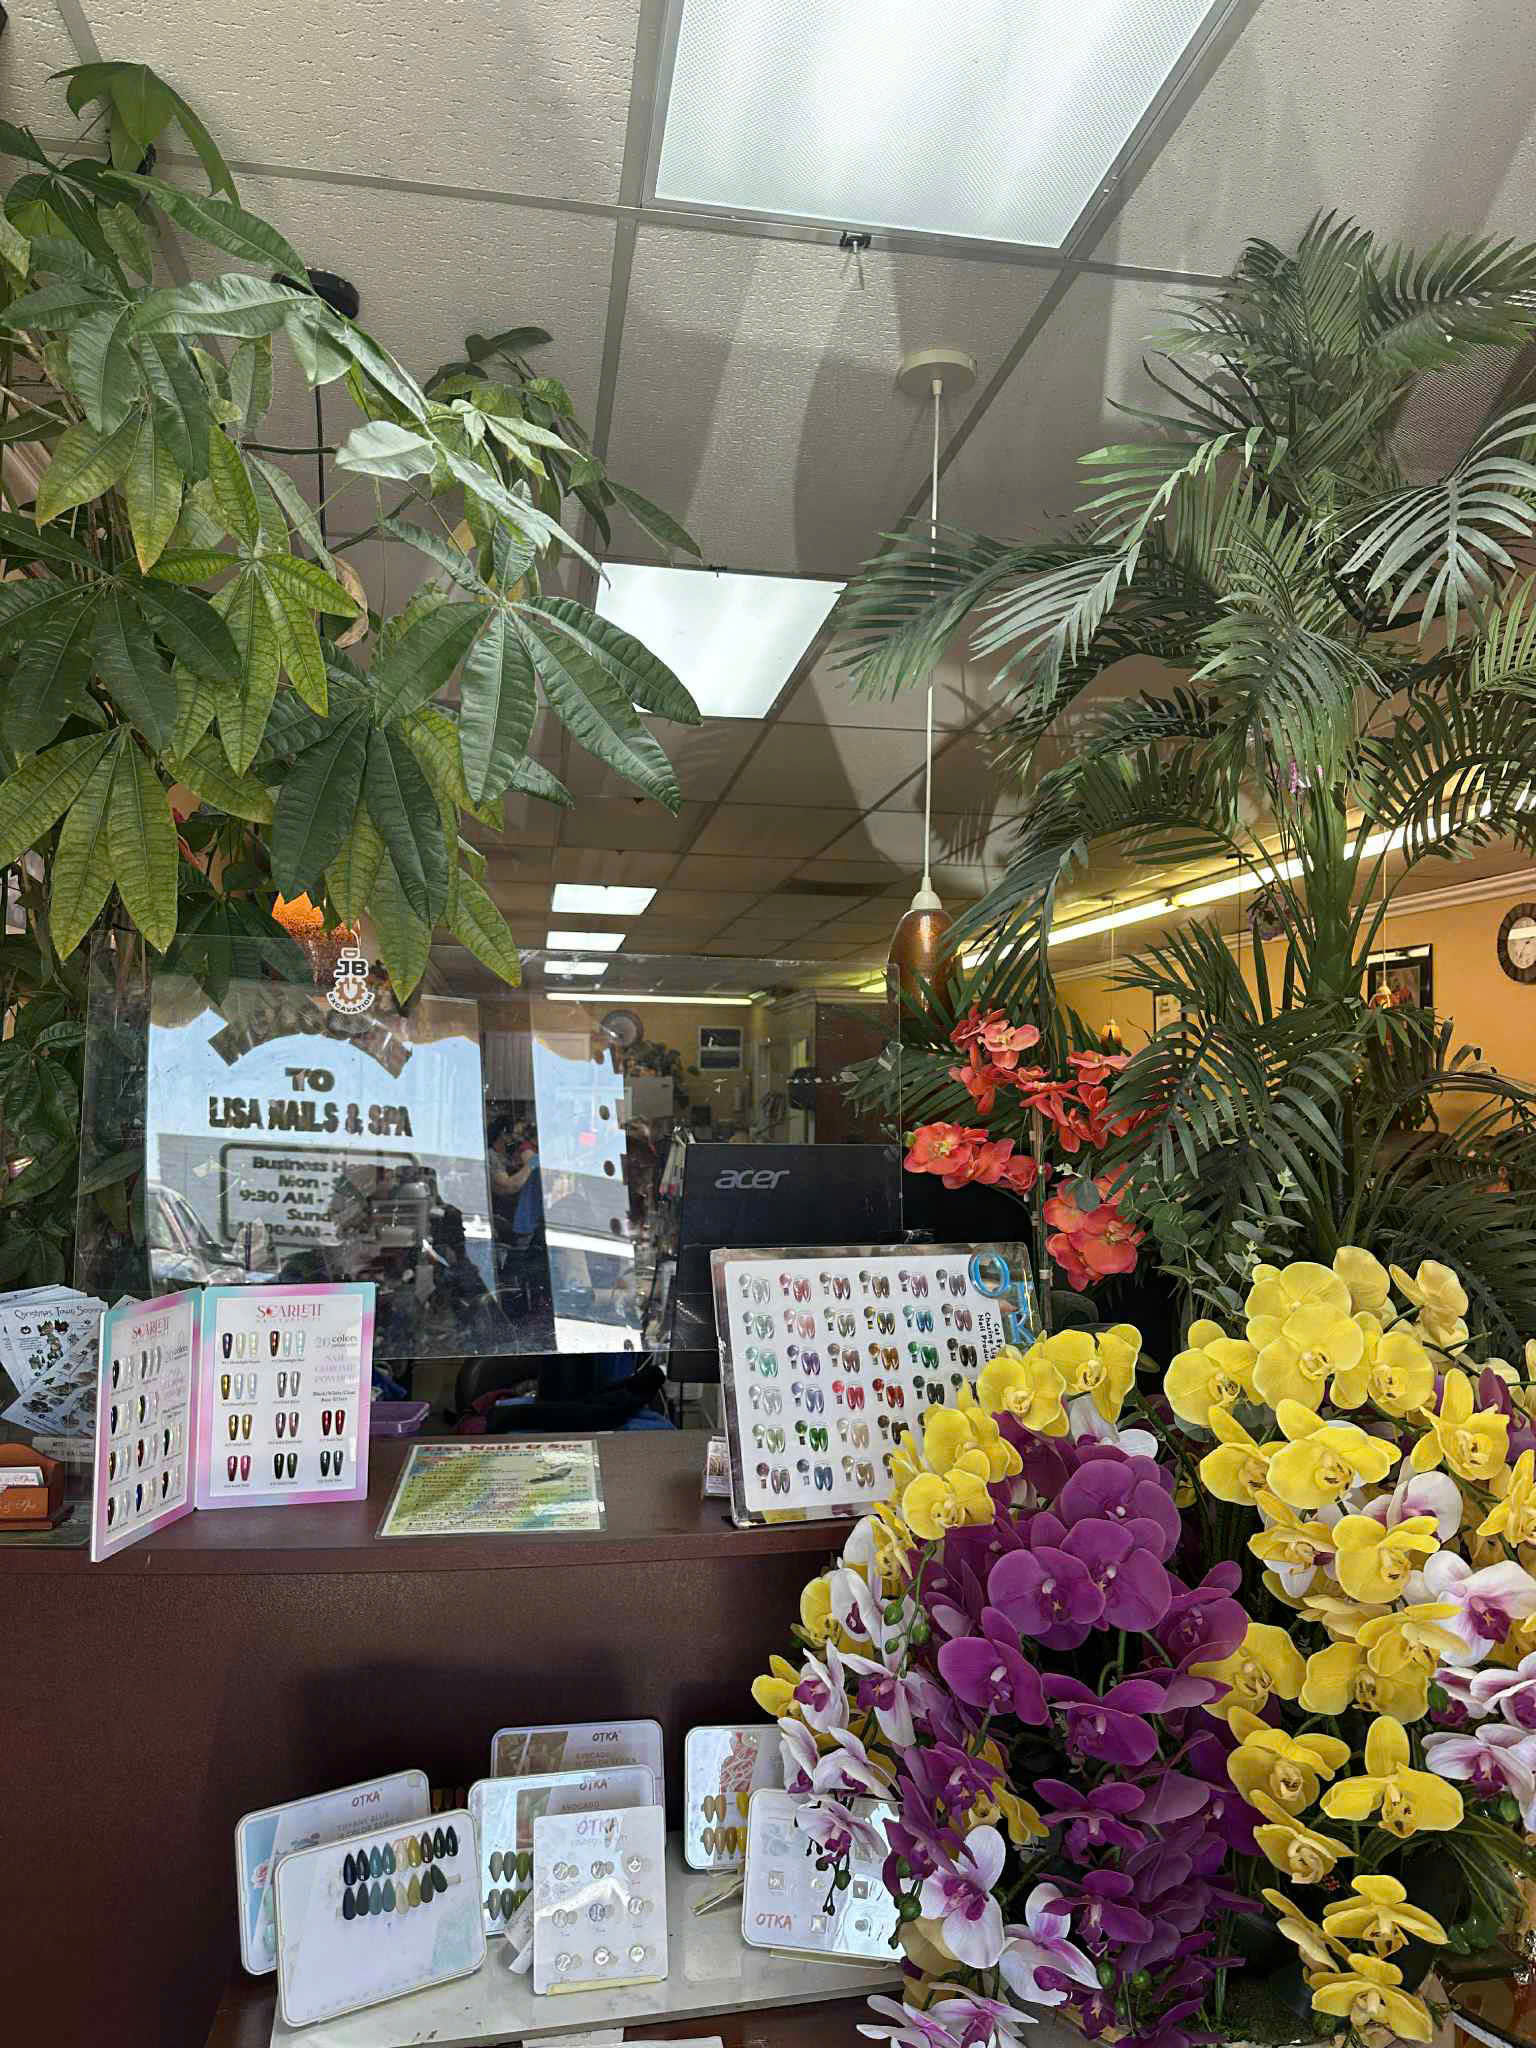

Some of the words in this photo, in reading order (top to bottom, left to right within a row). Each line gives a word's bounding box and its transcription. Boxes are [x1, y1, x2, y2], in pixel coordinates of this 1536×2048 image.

[335, 960, 367, 976] JB
[328, 992, 374, 1013] EXCAVATION
[285, 1067, 335, 1092] TO
[209, 1096, 264, 1129] LISA
[268, 1099, 339, 1133] NAILS
[345, 1103, 363, 1136] &
[368, 1104, 413, 1137] SPA
[252, 1156, 329, 1173] Business
[278, 1174, 319, 1189] Mon
[714, 1168, 790, 1190] acer
[239, 1189, 280, 1203] 9:30
[282, 1191, 314, 1206] AM
[286, 1208, 332, 1223] Sund
[290, 1225, 321, 1238] AM
[977, 1314, 986, 1332] Nail
[981, 1334, 990, 1362] Produ
[592, 1731, 619, 1742] OTKA
[579, 1778, 608, 1791] OTKA
[351, 1791, 381, 1808] OTKA
[576, 1816, 620, 1836] OTKA
[755, 1913, 793, 1930] OTKA
